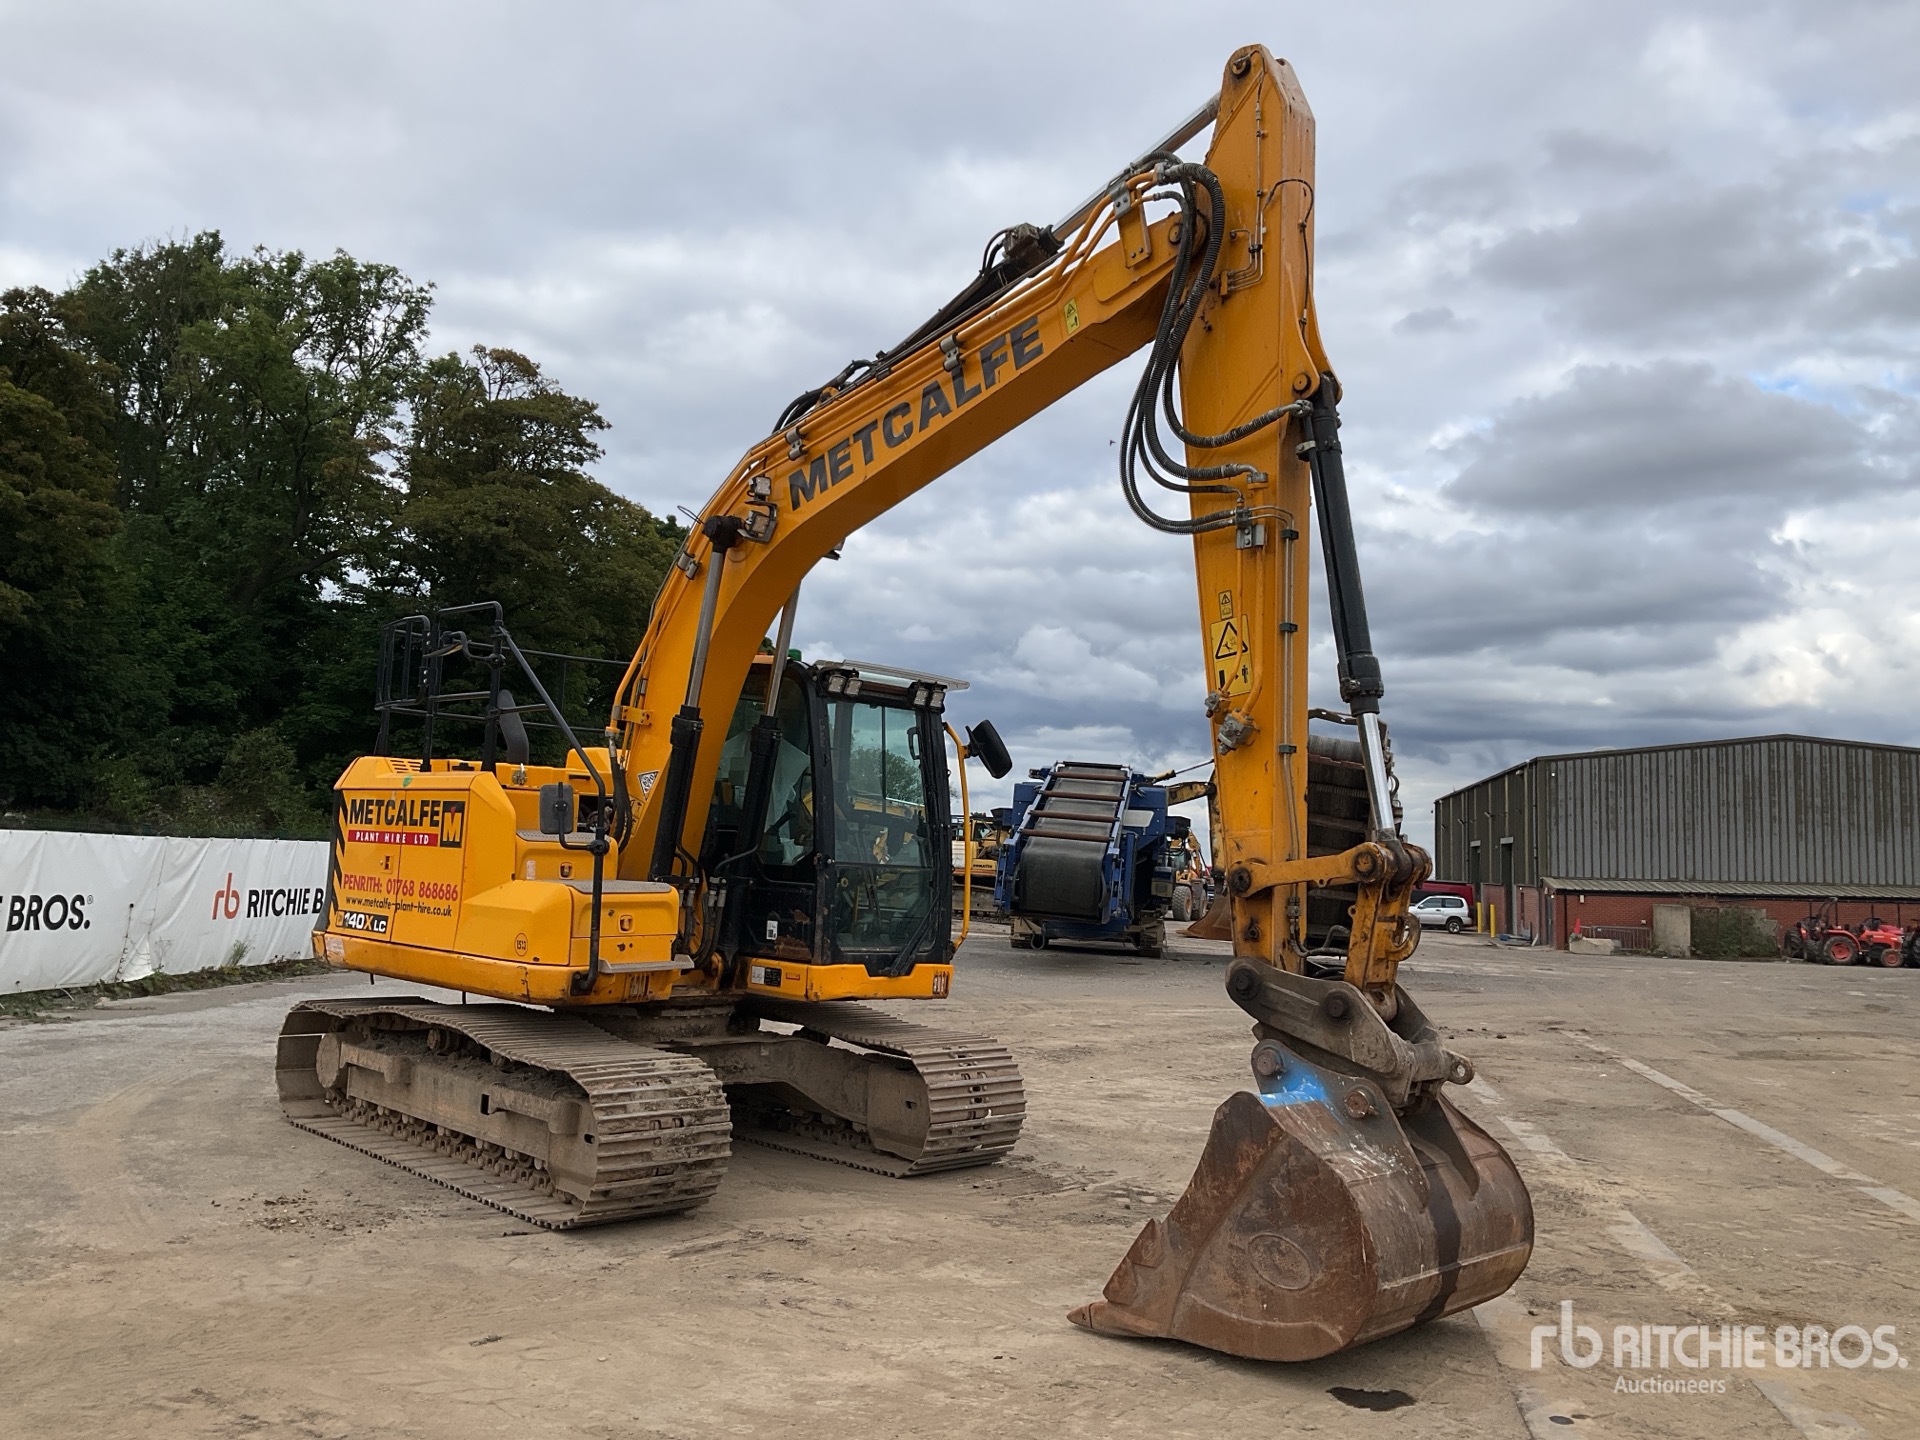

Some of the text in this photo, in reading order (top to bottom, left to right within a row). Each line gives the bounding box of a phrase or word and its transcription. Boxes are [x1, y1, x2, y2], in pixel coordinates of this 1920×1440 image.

[788, 315, 1044, 511] METCALFE
[349, 799, 441, 827] METCALFE
[442, 805, 463, 843] M
[355, 831, 430, 845] PLANT HIRE LTD
[343, 874, 459, 902] PENRITH: 01768 868686
[247, 888, 310, 919] RITCHIE
[346, 895, 453, 918] www.metcalfe-plant-hire.co.uk
